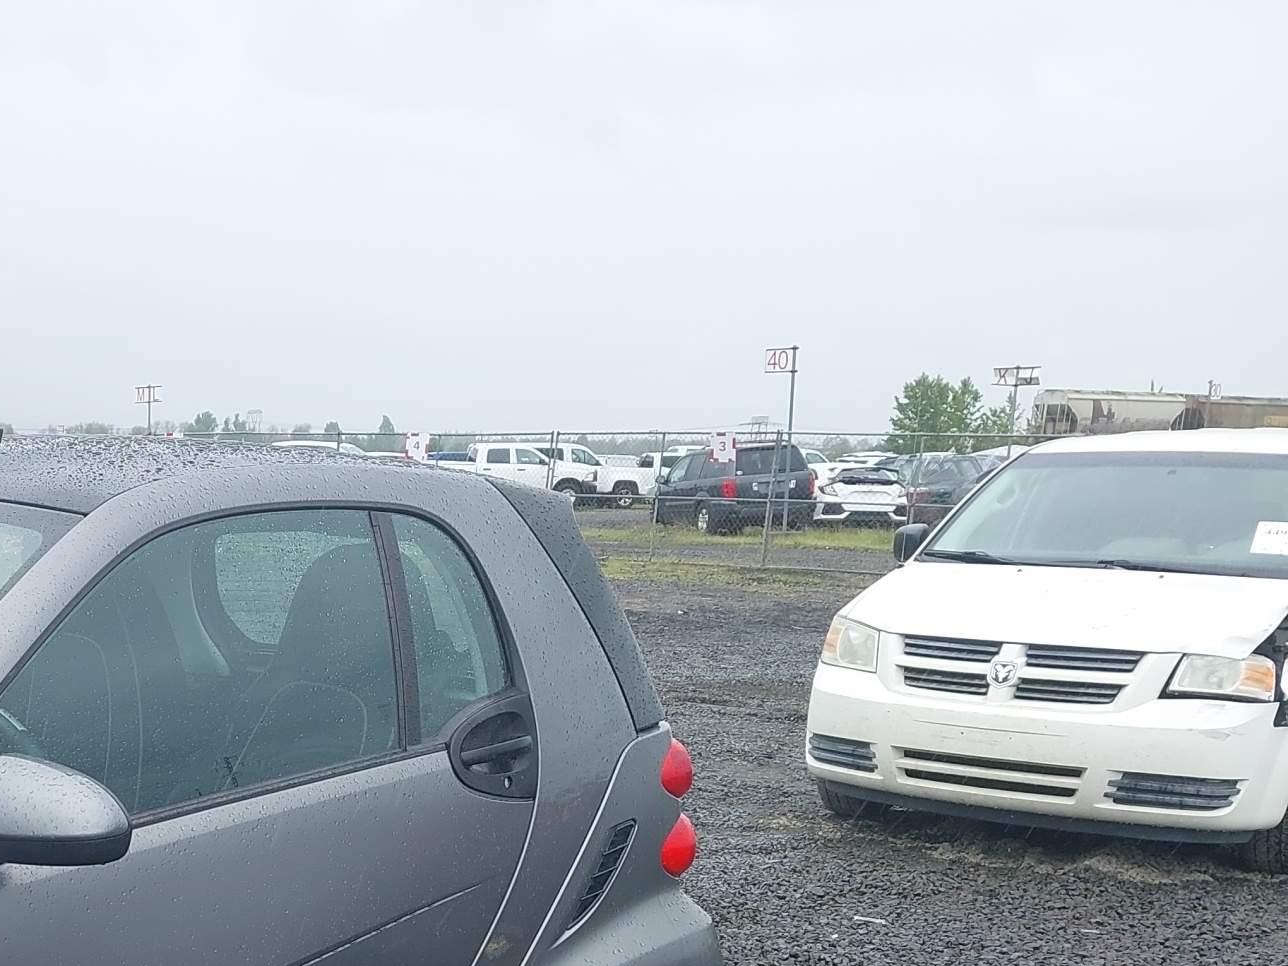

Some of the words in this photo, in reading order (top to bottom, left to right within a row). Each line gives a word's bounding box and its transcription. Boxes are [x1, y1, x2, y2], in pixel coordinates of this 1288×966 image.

[767, 350, 789, 370] 40
[413, 441, 420, 450] 4
[719, 441, 727, 451] 3
